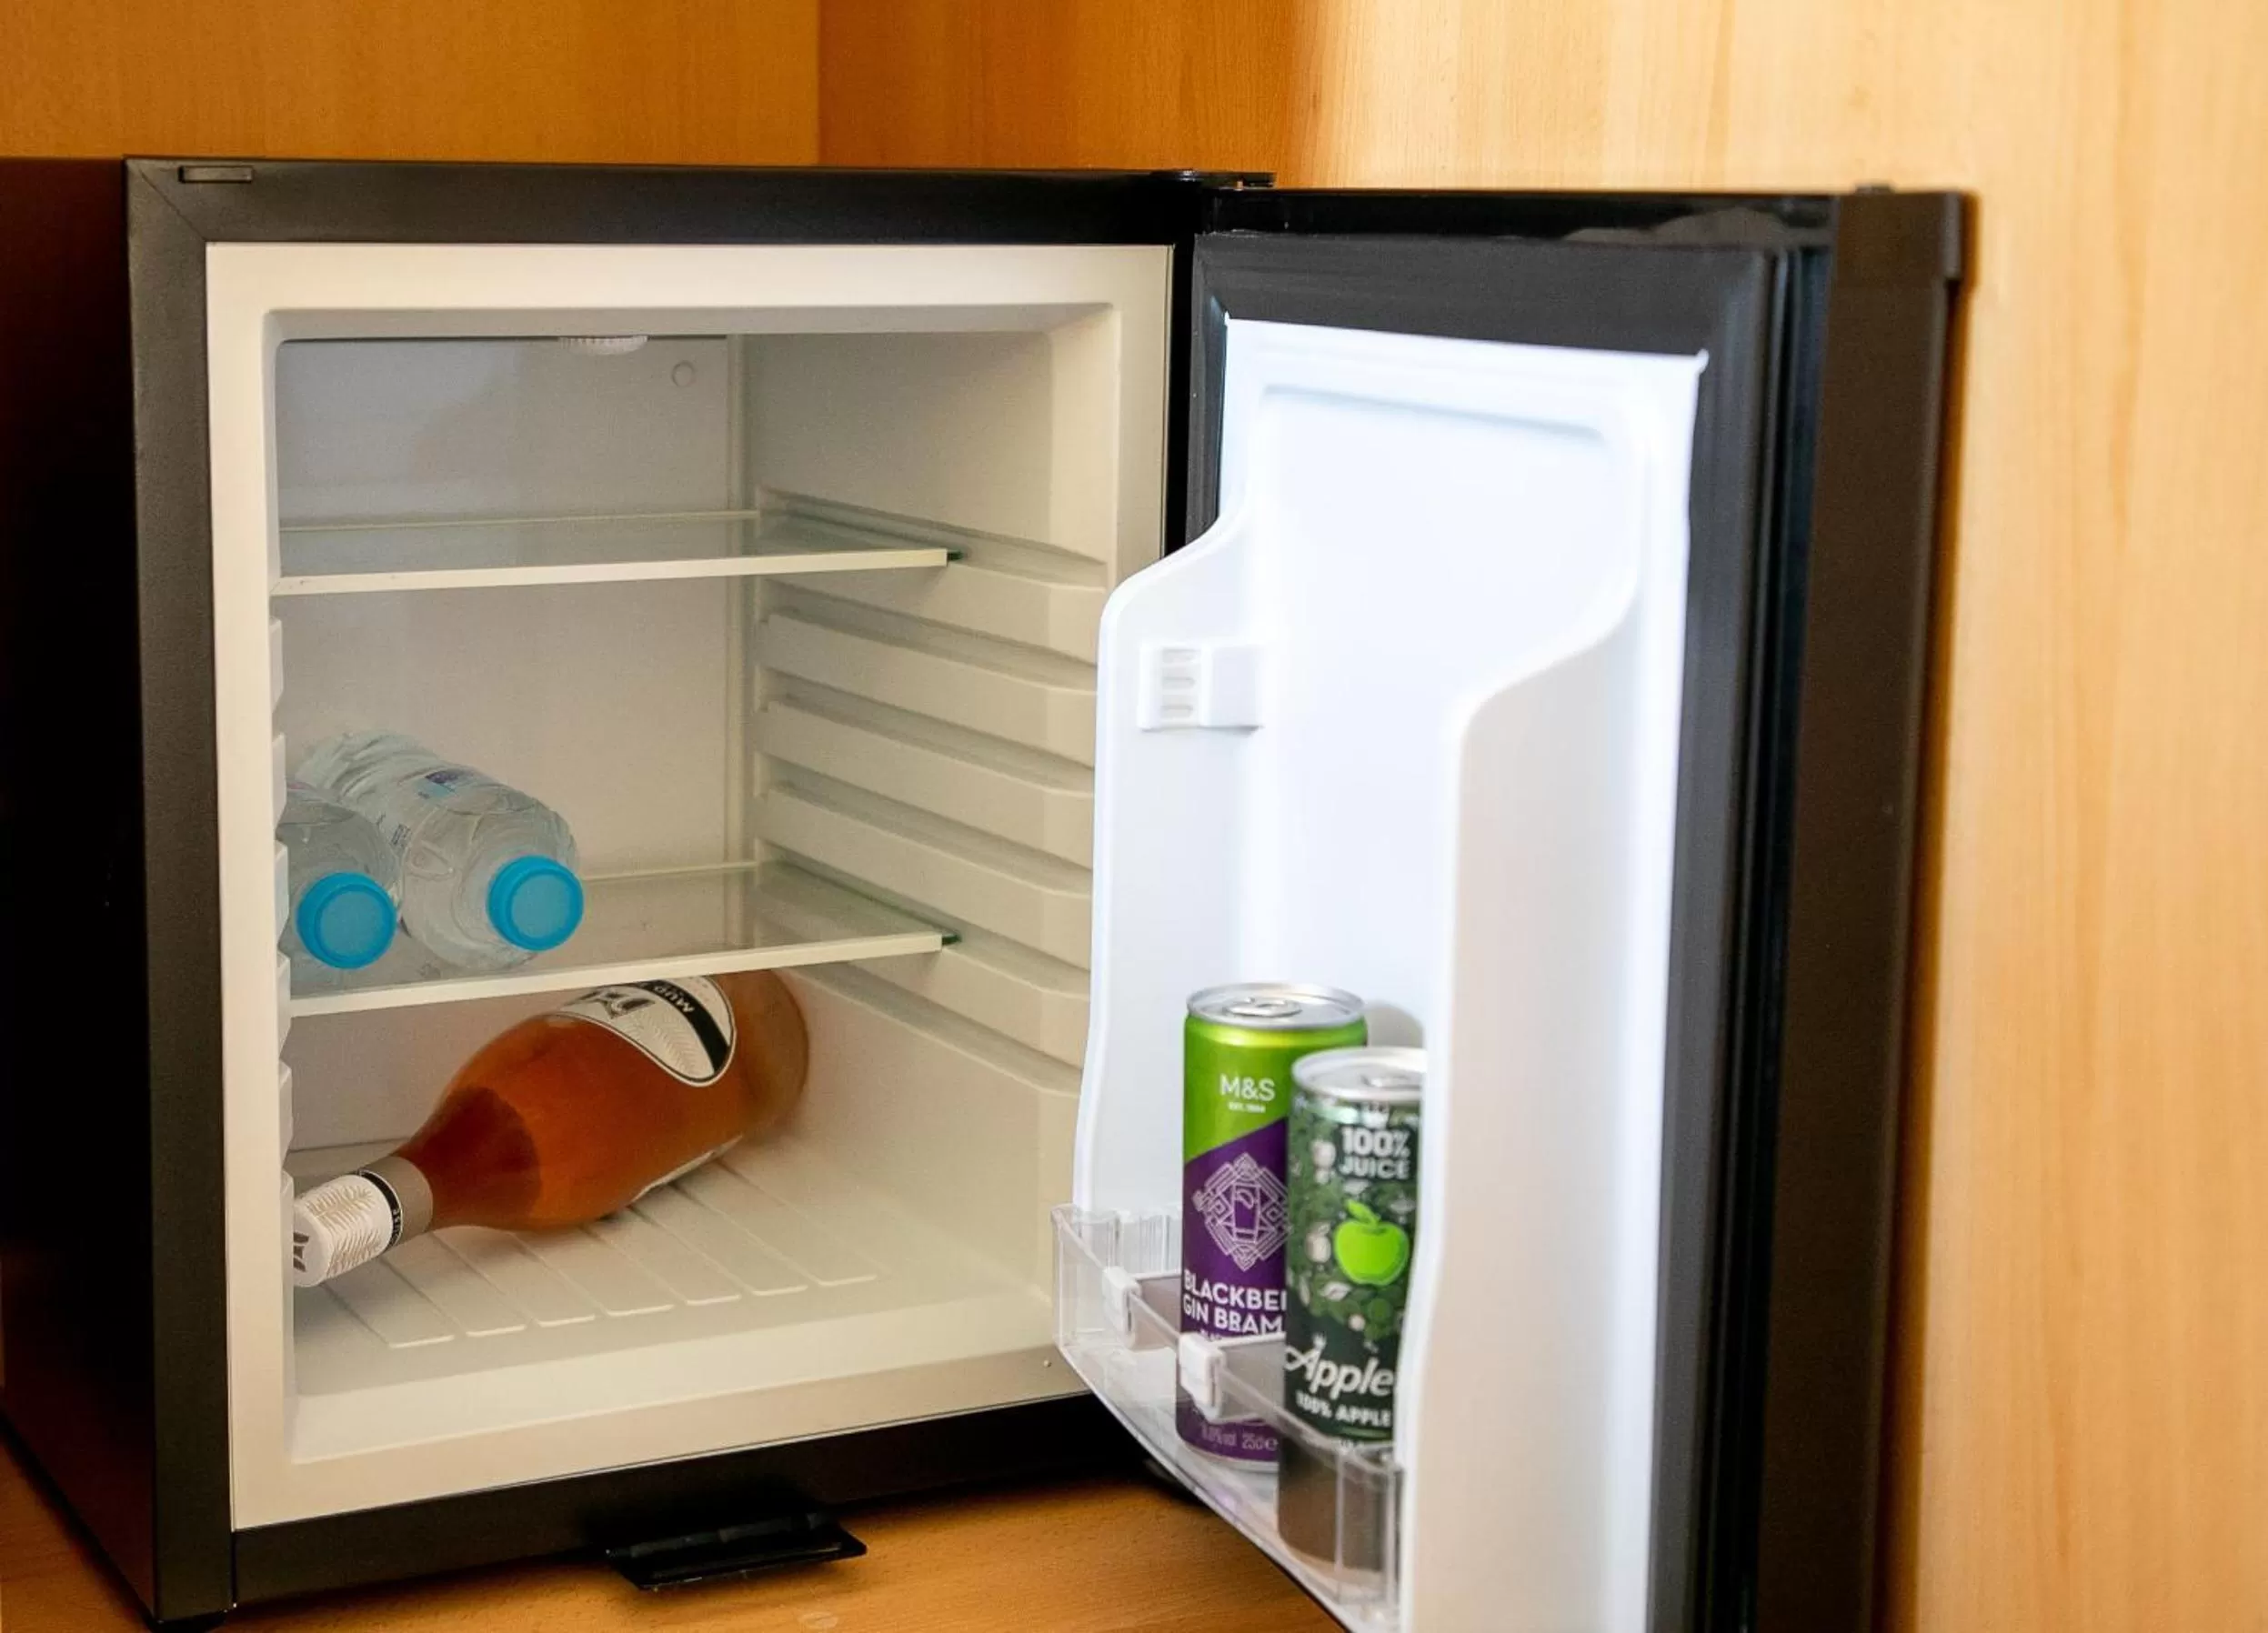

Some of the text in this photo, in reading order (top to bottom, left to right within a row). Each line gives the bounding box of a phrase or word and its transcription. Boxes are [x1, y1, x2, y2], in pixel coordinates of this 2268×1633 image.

[1219, 1073, 1276, 1101] M&S
[1340, 1126, 1410, 1158] 100%
[1339, 1156, 1410, 1180] JUICE
[1182, 1294, 1209, 1325] GIN
[1214, 1307, 1283, 1336] BRAM
[1284, 1343, 1394, 1401] Apple
[1335, 1403, 1392, 1428] APPLE
